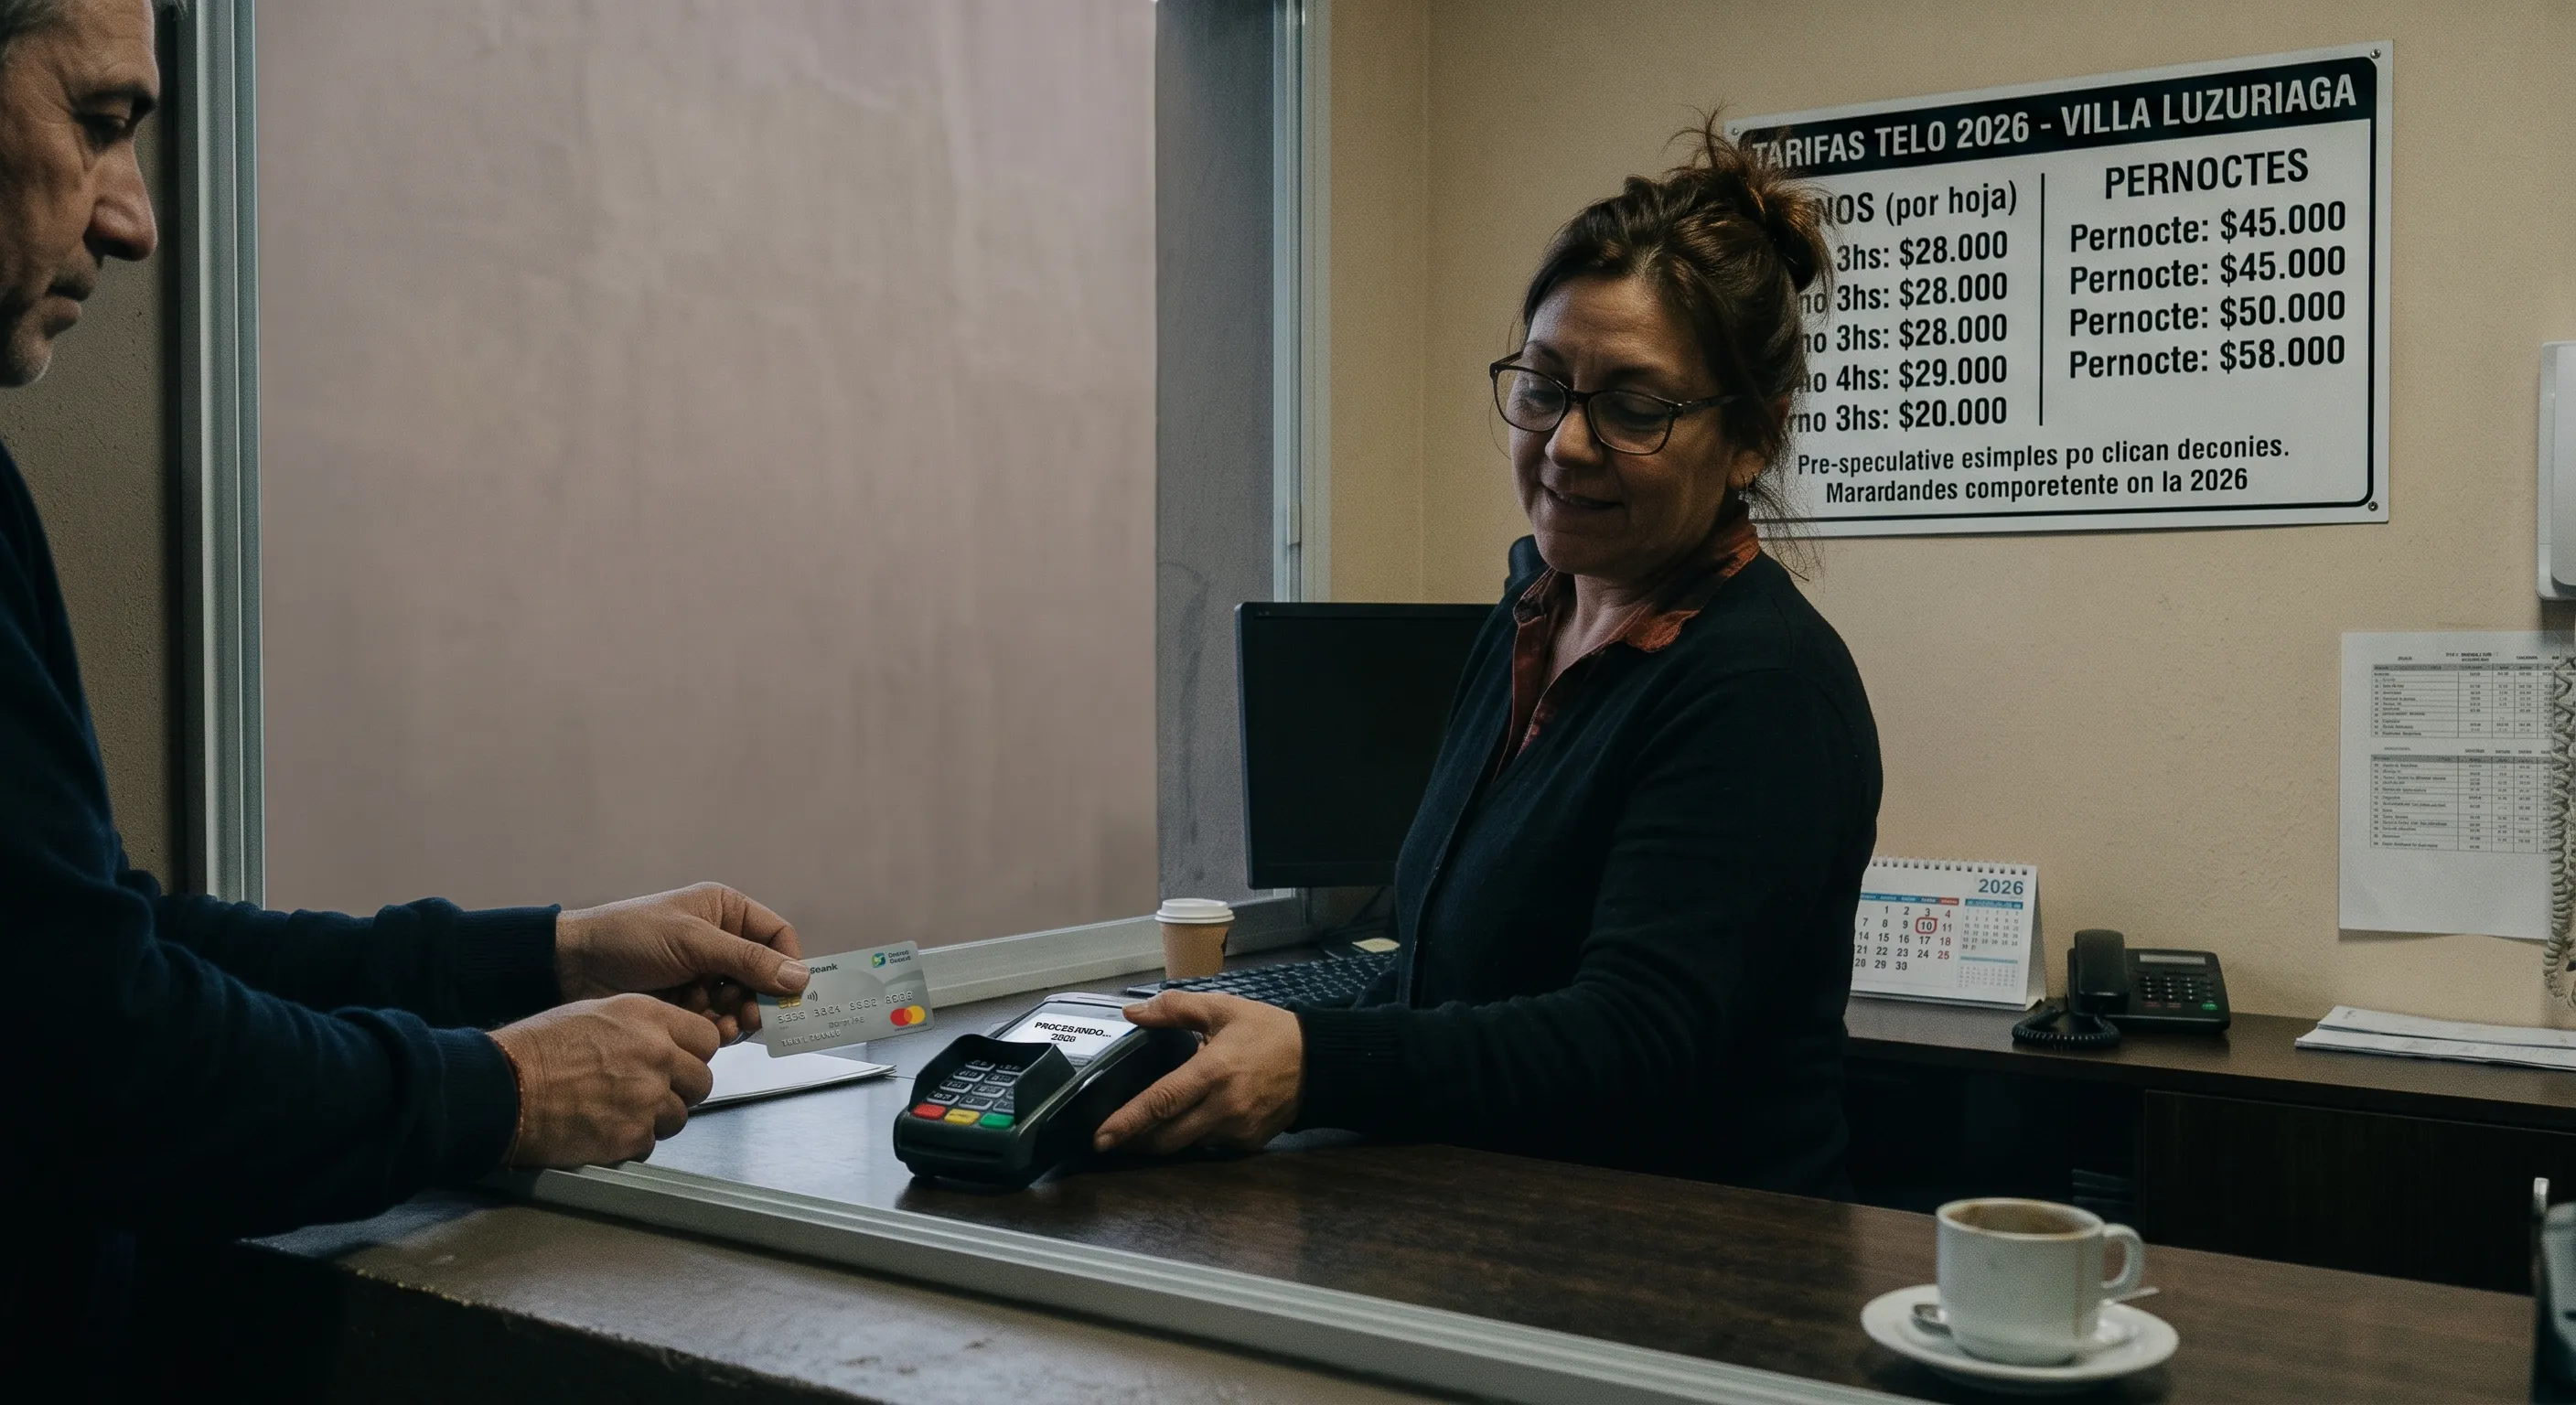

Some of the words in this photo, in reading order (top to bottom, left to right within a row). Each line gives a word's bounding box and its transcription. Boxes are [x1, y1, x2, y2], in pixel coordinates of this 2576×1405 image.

[1752, 130, 1865, 170] TARIFAS
[1874, 121, 1947, 157] TELO
[1957, 112, 2029, 149] 2026
[2060, 97, 2152, 136] VILLA
[2163, 73, 2356, 126] LUZURIAGA
[2105, 147, 2308, 200] PERNOCTES
[1816, 191, 1874, 228] NOS
[1885, 192, 1939, 227] (por
[1948, 179, 2017, 219] hoja)
[2070, 216, 2208, 253] Pernocte:
[2220, 200, 2345, 244] $45.000
[1836, 243, 1889, 273] 3hs:
[1899, 230, 2007, 270] $28.000
[2070, 259, 2208, 295] Pernocte:
[2220, 245, 2345, 288] $45.000
[1795, 290, 1828, 316] no
[1836, 284, 1889, 312] 3hs:
[1899, 265, 2008, 311] $28.000
[1836, 324, 1889, 352] 3hs:
[1899, 313, 2007, 351] $28.000
[2070, 302, 2208, 337] Pernocte:
[2219, 290, 2345, 332] $50.000
[1836, 364, 1889, 391] 4hs:
[1898, 355, 2007, 391] $29.000
[2070, 346, 2208, 379] Pernocte:
[2219, 334, 2345, 375] $58.000
[1836, 403, 1889, 432] 3hs:
[1898, 396, 2007, 430] $20.000
[1798, 448, 1954, 478] Pre-speculative
[1961, 445, 2058, 472] esimples
[2066, 446, 2094, 470] po
[2102, 440, 2169, 464] clican
[2177, 434, 2289, 460] deconies.
[1826, 478, 1958, 503] Marardandes
[1965, 474, 2119, 503] comporetente
[2127, 476, 2153, 494] on
[2163, 470, 2182, 493] la
[2190, 467, 2248, 492] 2026
[1978, 878, 2023, 896] 2026
[1862, 917, 1869, 927] 7
[1882, 918, 1888, 928] 8
[1902, 919, 1908, 929] 9
[1921, 921, 1935, 933] 10
[1942, 922, 1952, 933] 11
[1884, 905, 1889, 915] 1
[1903, 906, 1910, 916] 2
[1923, 907, 1931, 918] 3
[1944, 909, 1951, 918] 4
[1856, 944, 1868, 954] 21
[1875, 946, 1888, 956] 22
[1896, 948, 1909, 958] 23
[1916, 949, 1929, 959] 24
[1937, 949, 1950, 960] 25
[1858, 931, 1870, 941] 14
[1878, 932, 1890, 942] 15
[1898, 933, 1910, 944] 16
[1919, 935, 1931, 945] 17
[1939, 937, 1951, 947] 18
